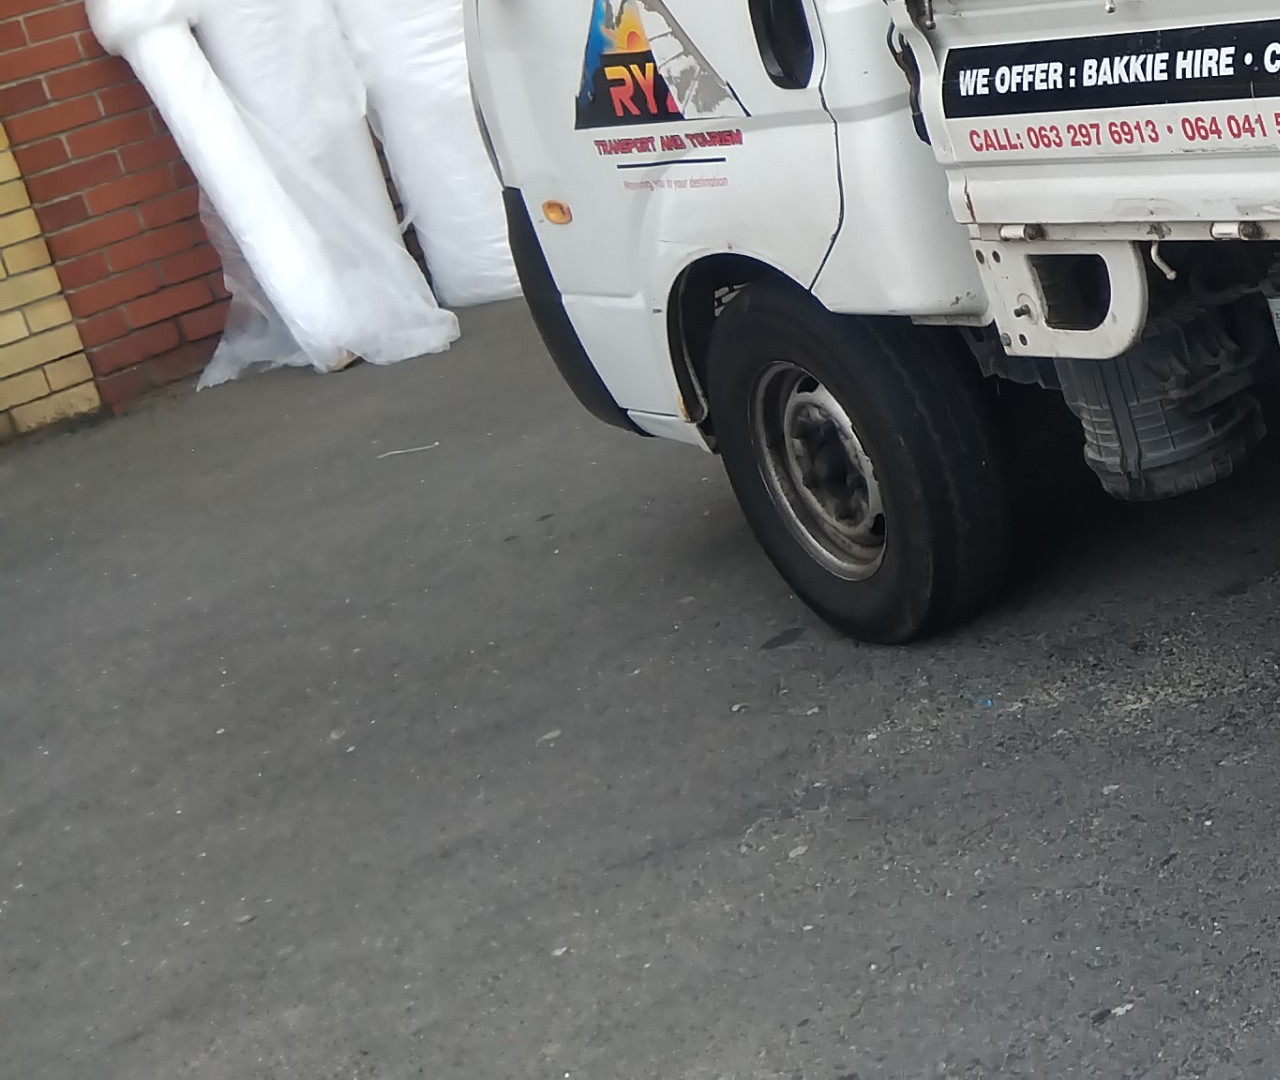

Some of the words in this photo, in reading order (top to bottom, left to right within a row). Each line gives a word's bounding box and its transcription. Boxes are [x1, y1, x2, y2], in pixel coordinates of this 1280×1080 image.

[959, 67, 990, 97] WE
[995, 61, 1064, 94] OFFER
[1082, 52, 1169, 88] BAKKIE
[1175, 46, 1235, 80] HIRE
[594, 136, 657, 155] TRANSPORT
[660, 134, 686, 152] AND
[685, 129, 744, 149] TOURISM
[968, 127, 1025, 153] CALL:
[1026, 125, 1064, 149] 063
[1066, 122, 1102, 147] 297
[1108, 119, 1160, 145] 6913
[1181, 116, 1223, 141] 064
[1227, 113, 1267, 139] 041
